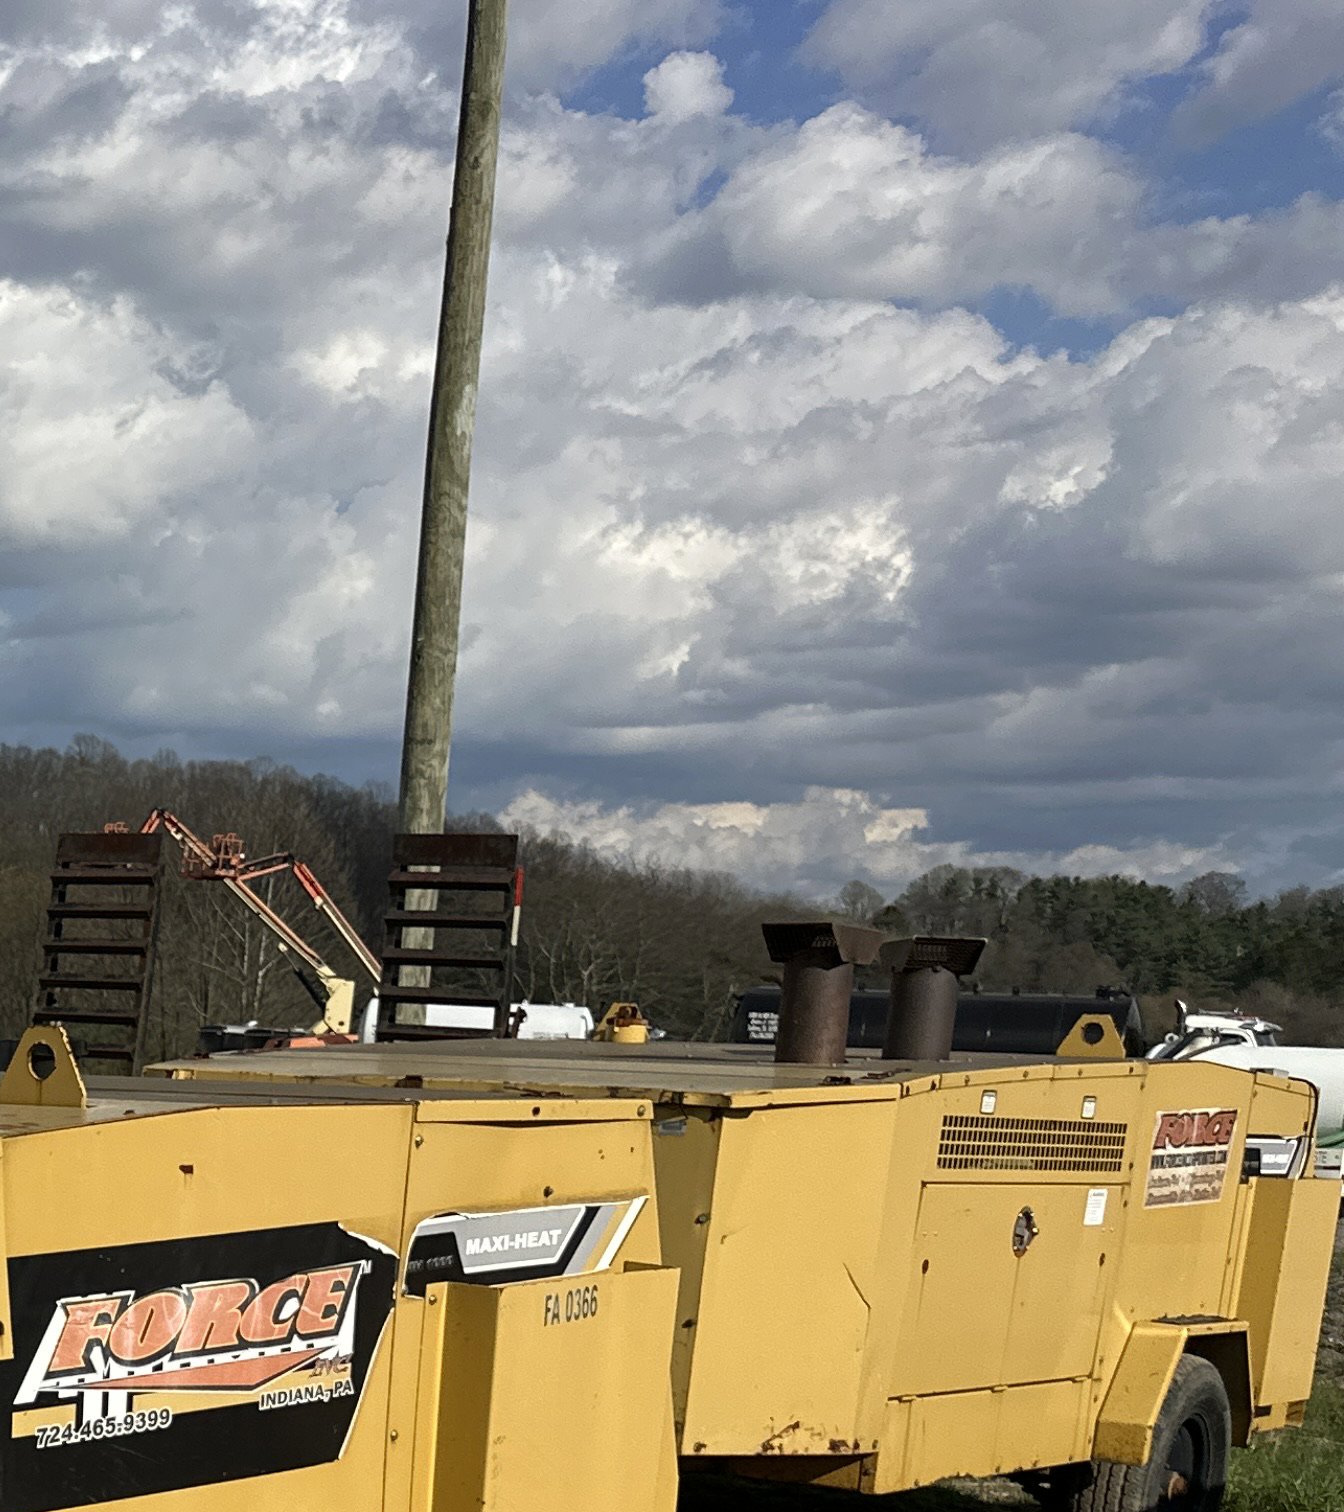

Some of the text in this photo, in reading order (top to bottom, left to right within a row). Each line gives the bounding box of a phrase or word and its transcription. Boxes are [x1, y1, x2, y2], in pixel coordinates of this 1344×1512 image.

[465, 1229, 562, 1255] MAXI-HEAT
[41, 1262, 364, 1381] FORCE
[543, 1284, 599, 1328] FA 0366
[258, 1378, 355, 1411] INDIANA, PA
[36, 1407, 173, 1449] 724.465.9399
